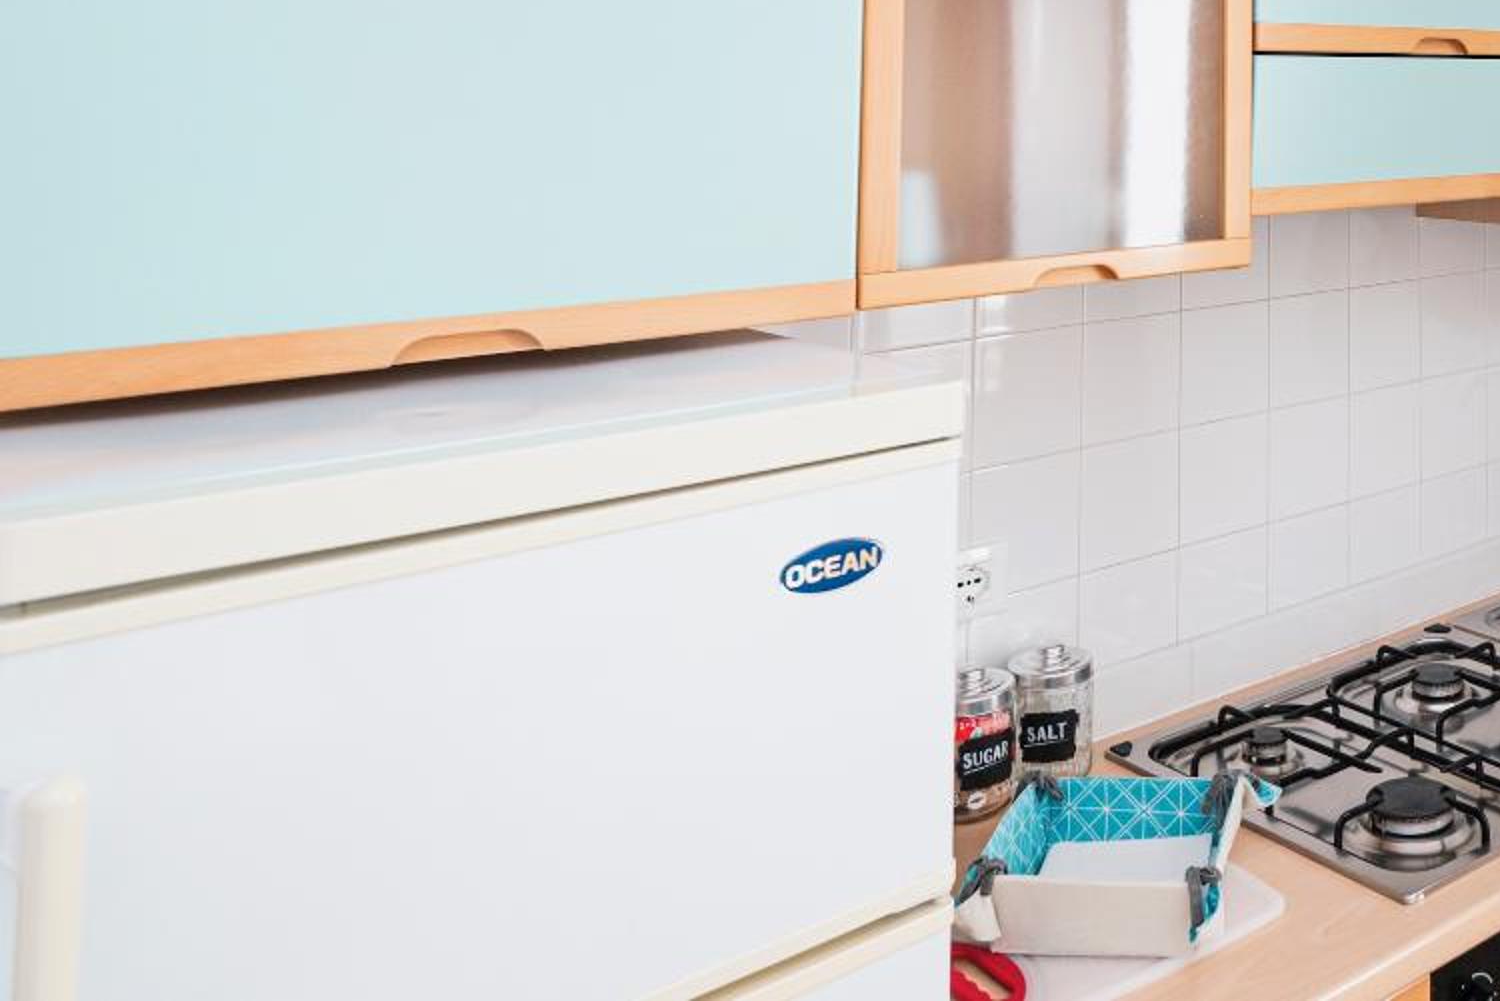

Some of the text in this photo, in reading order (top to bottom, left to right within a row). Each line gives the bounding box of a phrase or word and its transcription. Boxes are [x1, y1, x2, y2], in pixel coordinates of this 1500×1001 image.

[785, 546, 878, 589] OCEAN
[1026, 721, 1068, 742] SALT
[963, 740, 1009, 769] SUGAR
